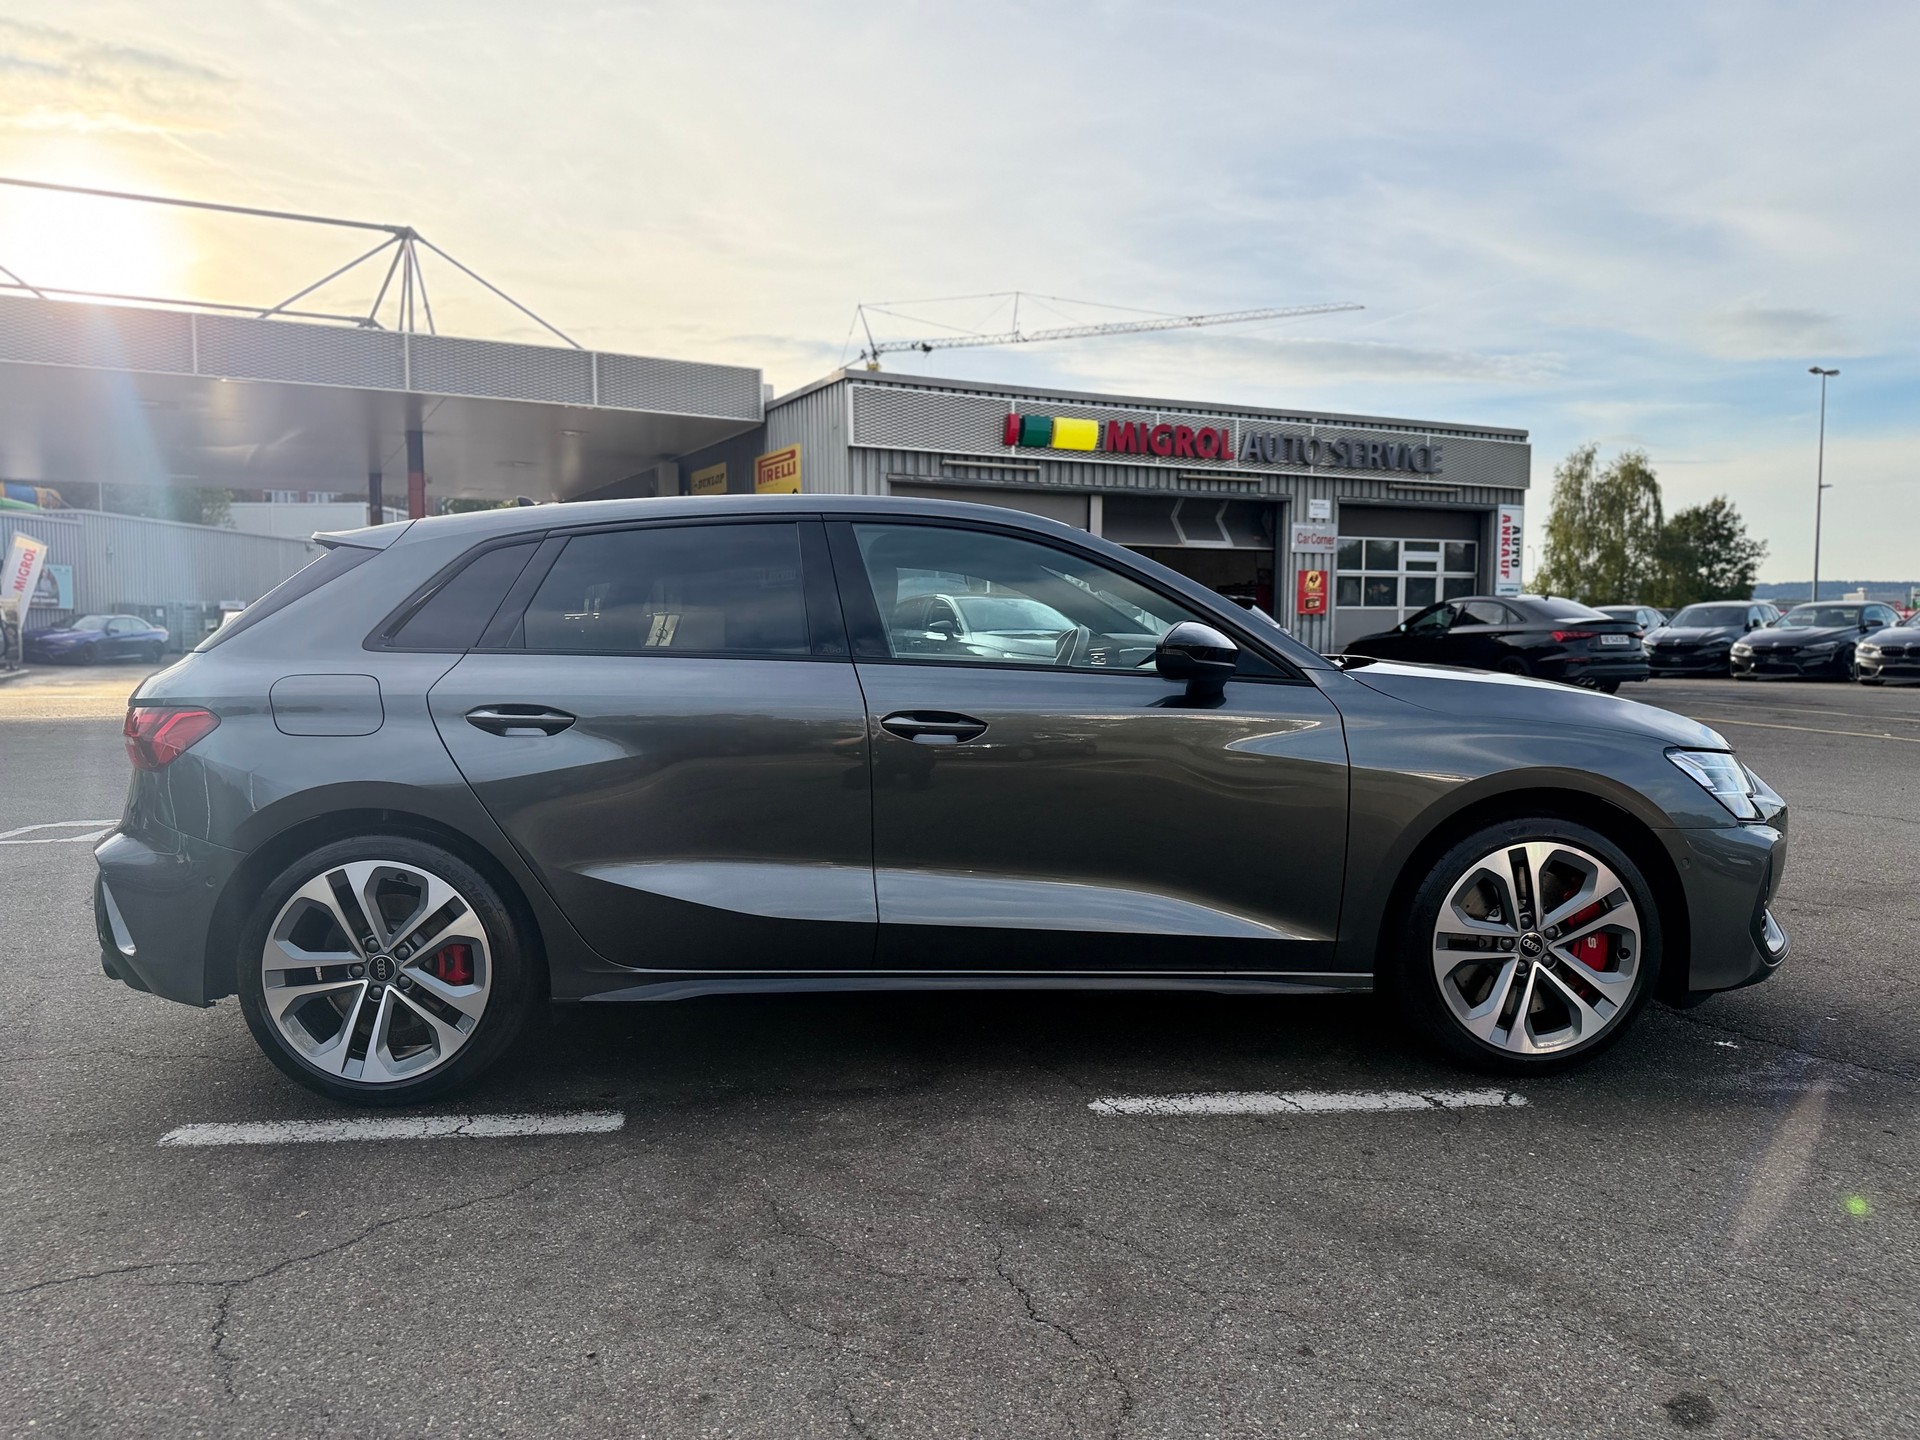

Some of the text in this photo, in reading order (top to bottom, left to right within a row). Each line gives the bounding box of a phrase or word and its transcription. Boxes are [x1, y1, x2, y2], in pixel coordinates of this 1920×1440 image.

[758, 449, 796, 485] PIRELLI
[1105, 420, 1443, 473] MIGROL AUTO SERVICE
[698, 473, 725, 489] DUNLOP
[1500, 514, 1511, 579] ANKAUF
[1511, 525, 1521, 568] AUTO
[13, 548, 37, 592] MIGROL
[1588, 937, 1597, 949] S
